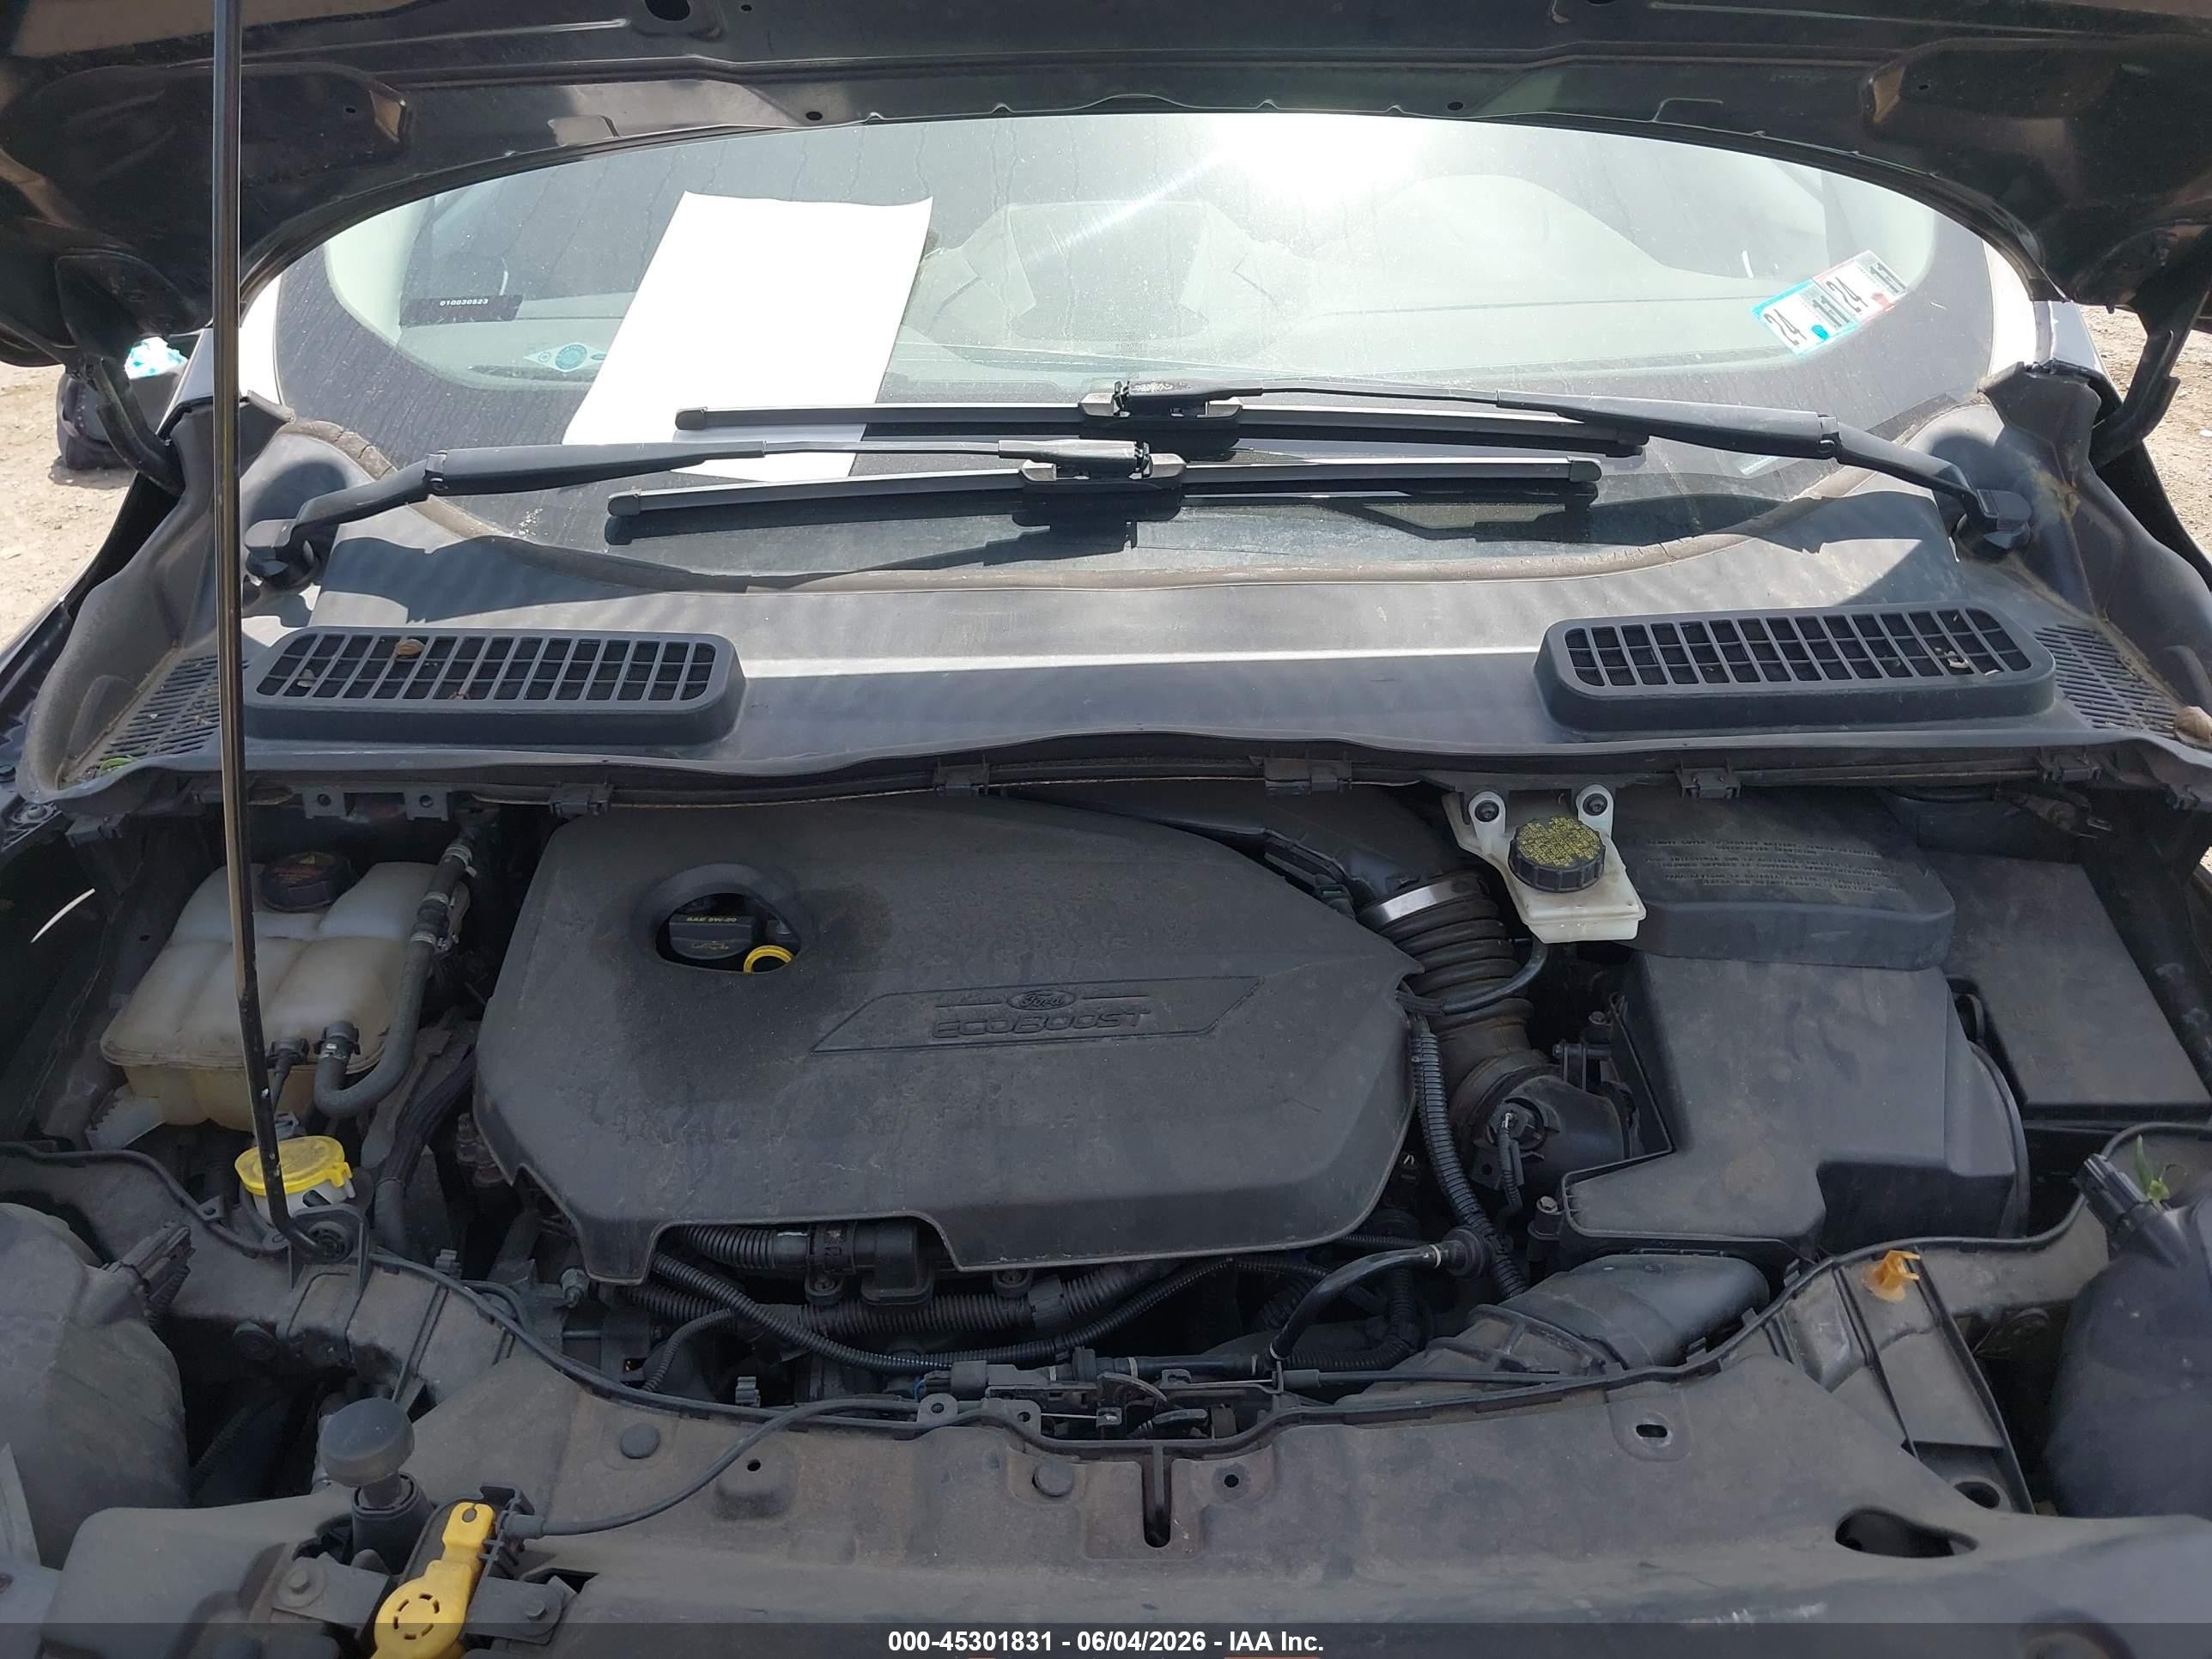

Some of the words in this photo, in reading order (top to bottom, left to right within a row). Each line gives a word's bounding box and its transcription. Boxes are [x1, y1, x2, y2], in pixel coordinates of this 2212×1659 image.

[1826, 276, 1869, 313] 24
[1866, 261, 1905, 293] 11
[1763, 307, 1807, 346] 24
[1812, 295, 1850, 327] 11
